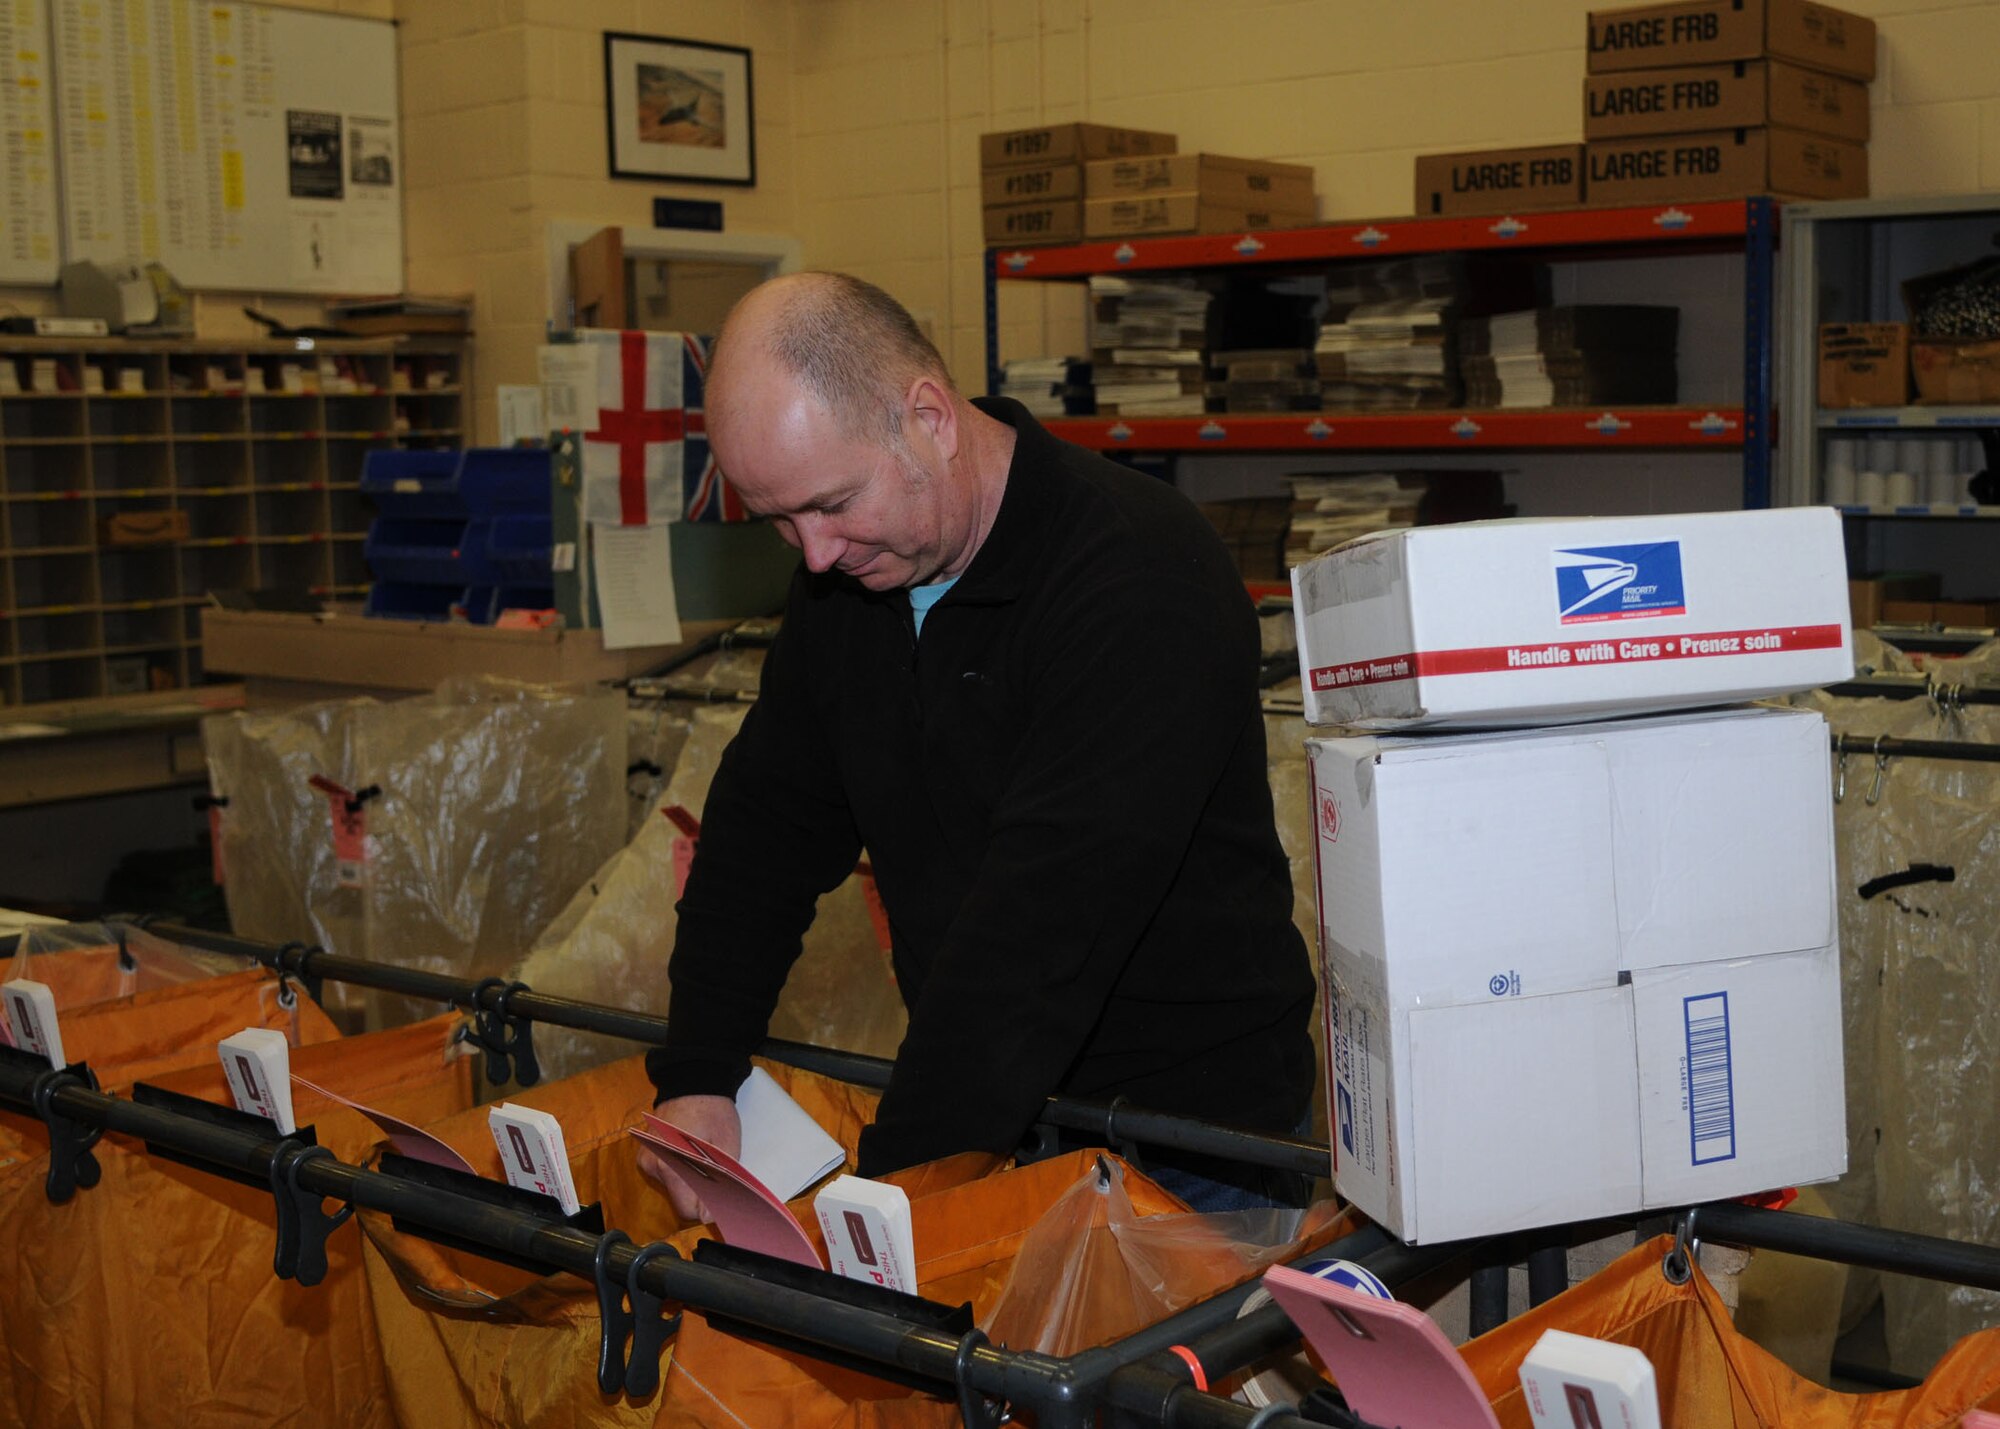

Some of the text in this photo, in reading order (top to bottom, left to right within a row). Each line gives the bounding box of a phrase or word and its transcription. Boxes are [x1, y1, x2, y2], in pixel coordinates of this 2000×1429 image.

[1588, 13, 1719, 53] LARGE FRB
[1589, 79, 1720, 118] LARGE FRB
[1452, 157, 1573, 193] LARGE FRB
[1590, 146, 1721, 182] LARGE FRB
[1622, 585, 1658, 595] PRIORITY
[1622, 594, 1642, 603] MAIL
[1507, 632, 1781, 667] Handle with Care Prenez soin
[1315, 658, 1409, 687] Handle with Care Prenez soin
[1342, 1032, 1351, 1085] MAIL
[879, 1251, 893, 1274] THIS
